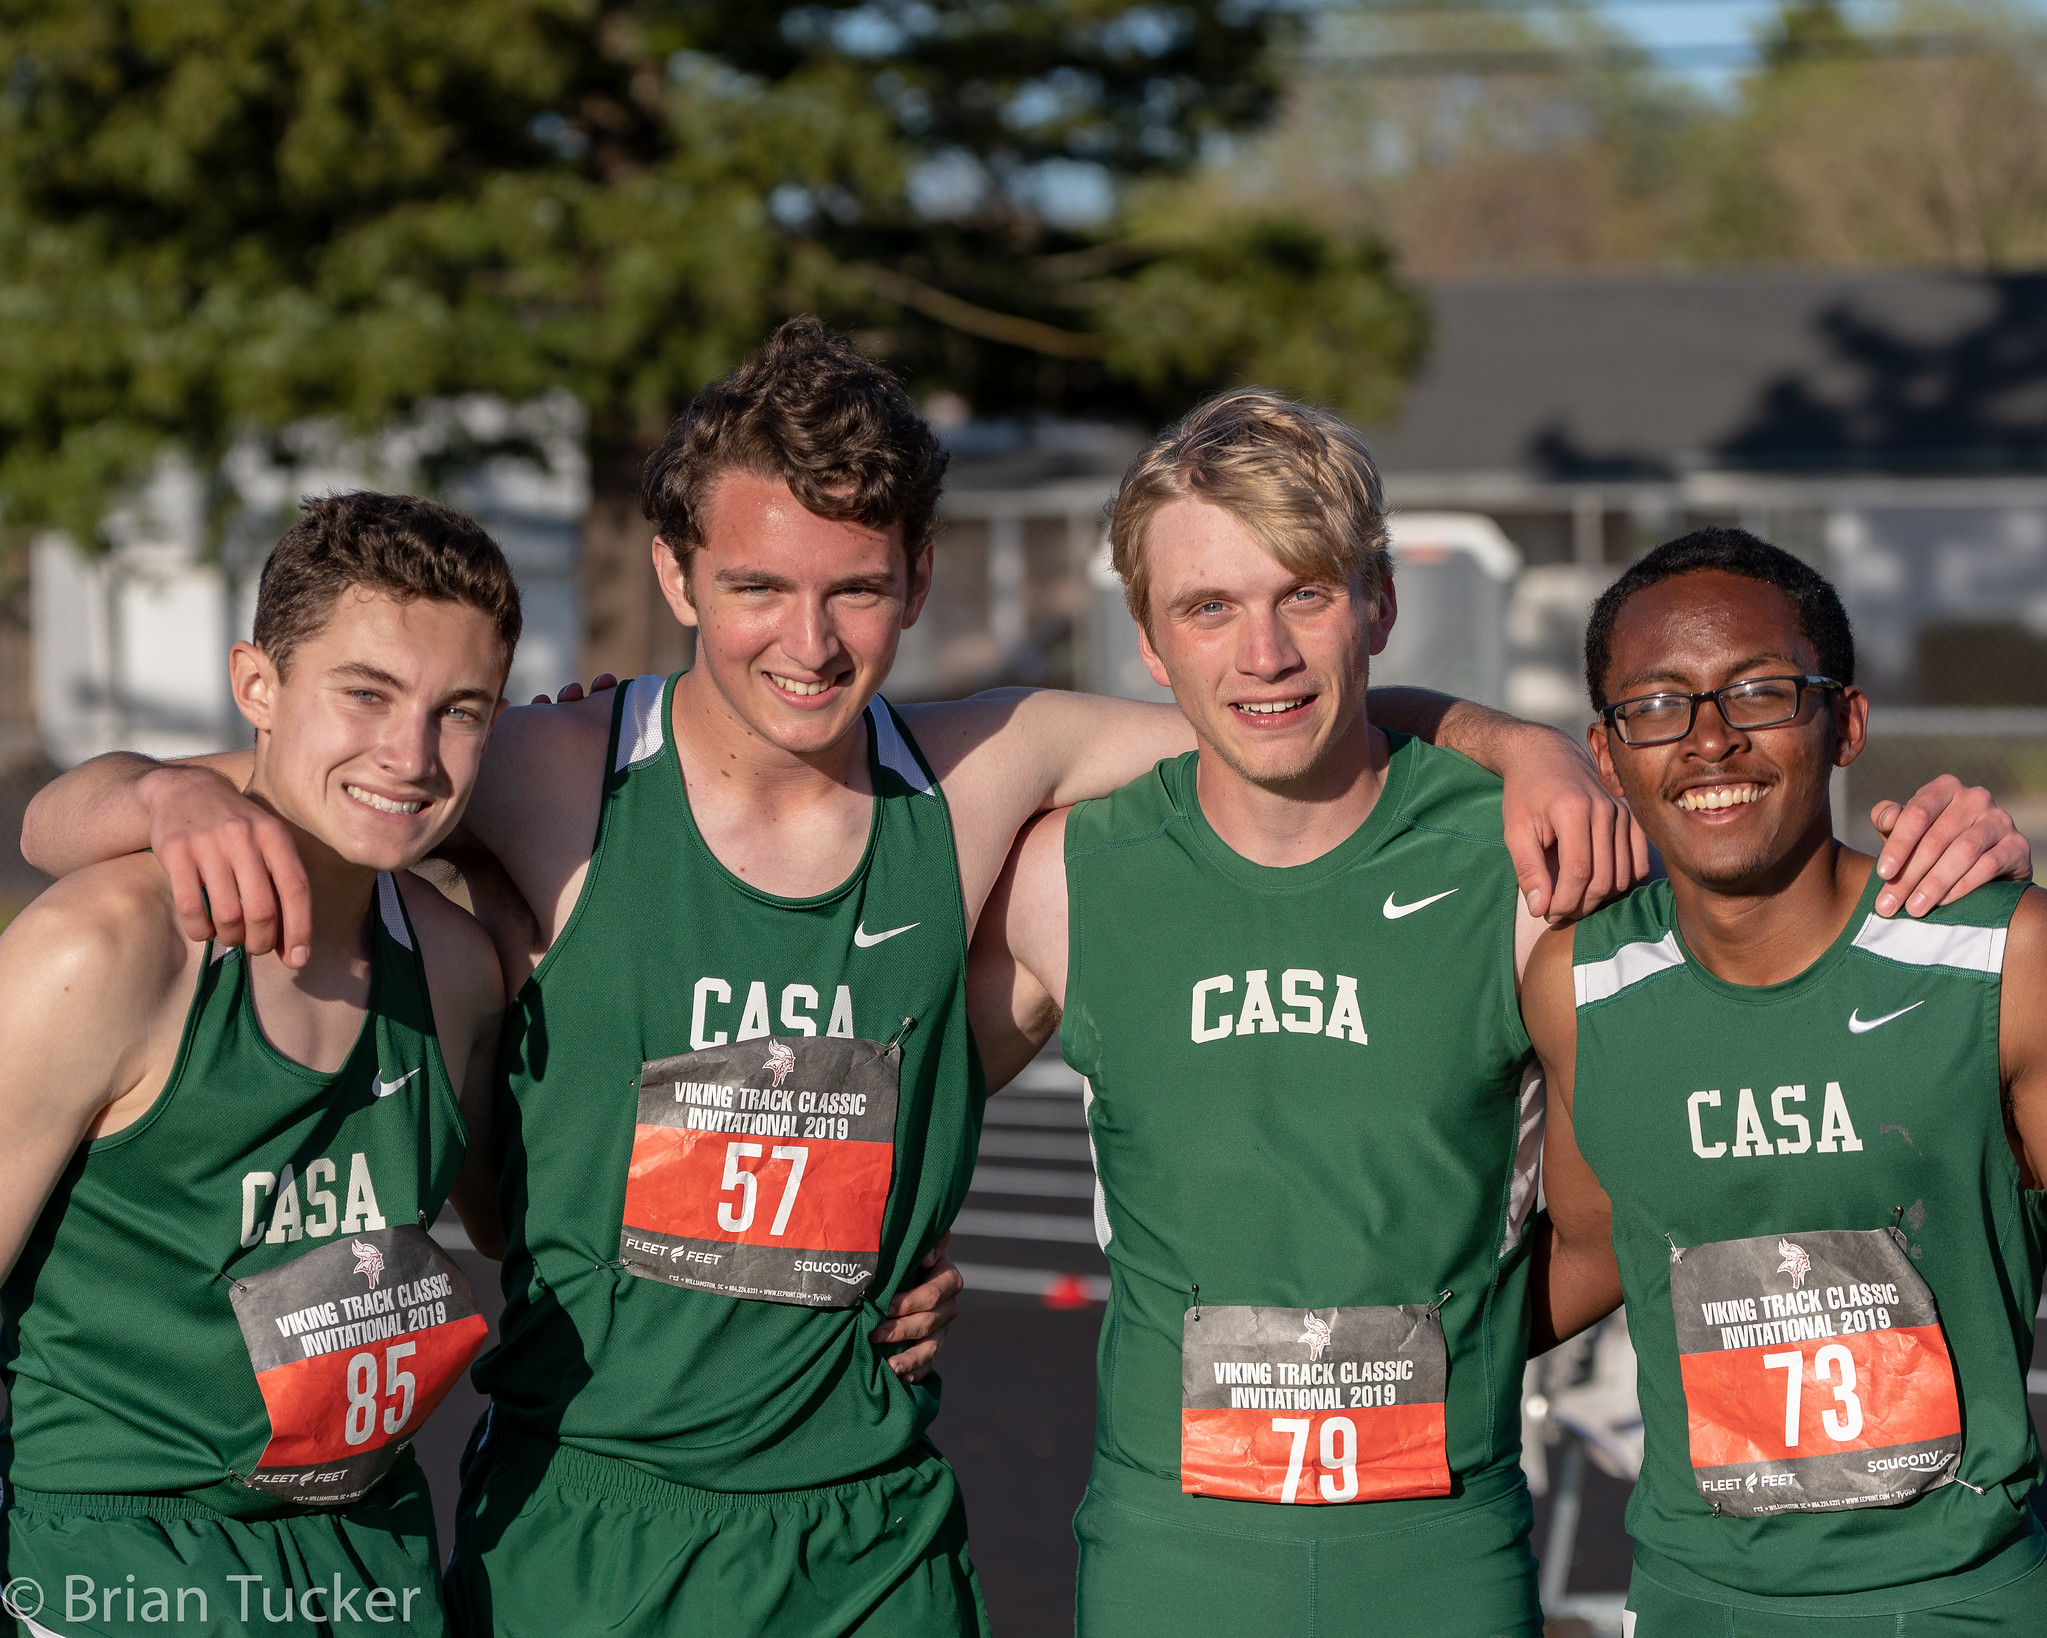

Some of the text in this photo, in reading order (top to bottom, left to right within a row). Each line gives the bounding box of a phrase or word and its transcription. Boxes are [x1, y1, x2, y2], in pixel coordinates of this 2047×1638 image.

[690, 977, 854, 1051] CASA
[1191, 968, 1368, 1046] CASA
[674, 1082, 867, 1116] VIKING TRACK CLASSIC
[1687, 1081, 1863, 1159] CASA
[687, 1107, 849, 1140] INVITATIONAL 2019
[240, 1152, 386, 1248] CASA
[716, 1142, 809, 1236] 57
[625, 1238, 722, 1265] FLEET FEET
[793, 1260, 857, 1277] saucony
[275, 1273, 452, 1337] VIKING TRACK CLASSIC
[1701, 1283, 1899, 1327] VIKING TRACK CLASSIC
[300, 1301, 447, 1358] INVITATIONAL 2019
[1720, 1307, 1891, 1350] INVITATIONAL 2019
[344, 1340, 416, 1446] 85
[1213, 1359, 1414, 1385] VIKING TRACK CLASSIC
[1231, 1384, 1396, 1410] INVITATIONAL 2019
[1763, 1344, 1863, 1448] 73
[254, 1469, 348, 1483] FLEET FEET
[1272, 1416, 1358, 1504] 79
[1867, 1451, 1939, 1472] saucony
[1702, 1473, 1796, 1492] FLEET FEET
